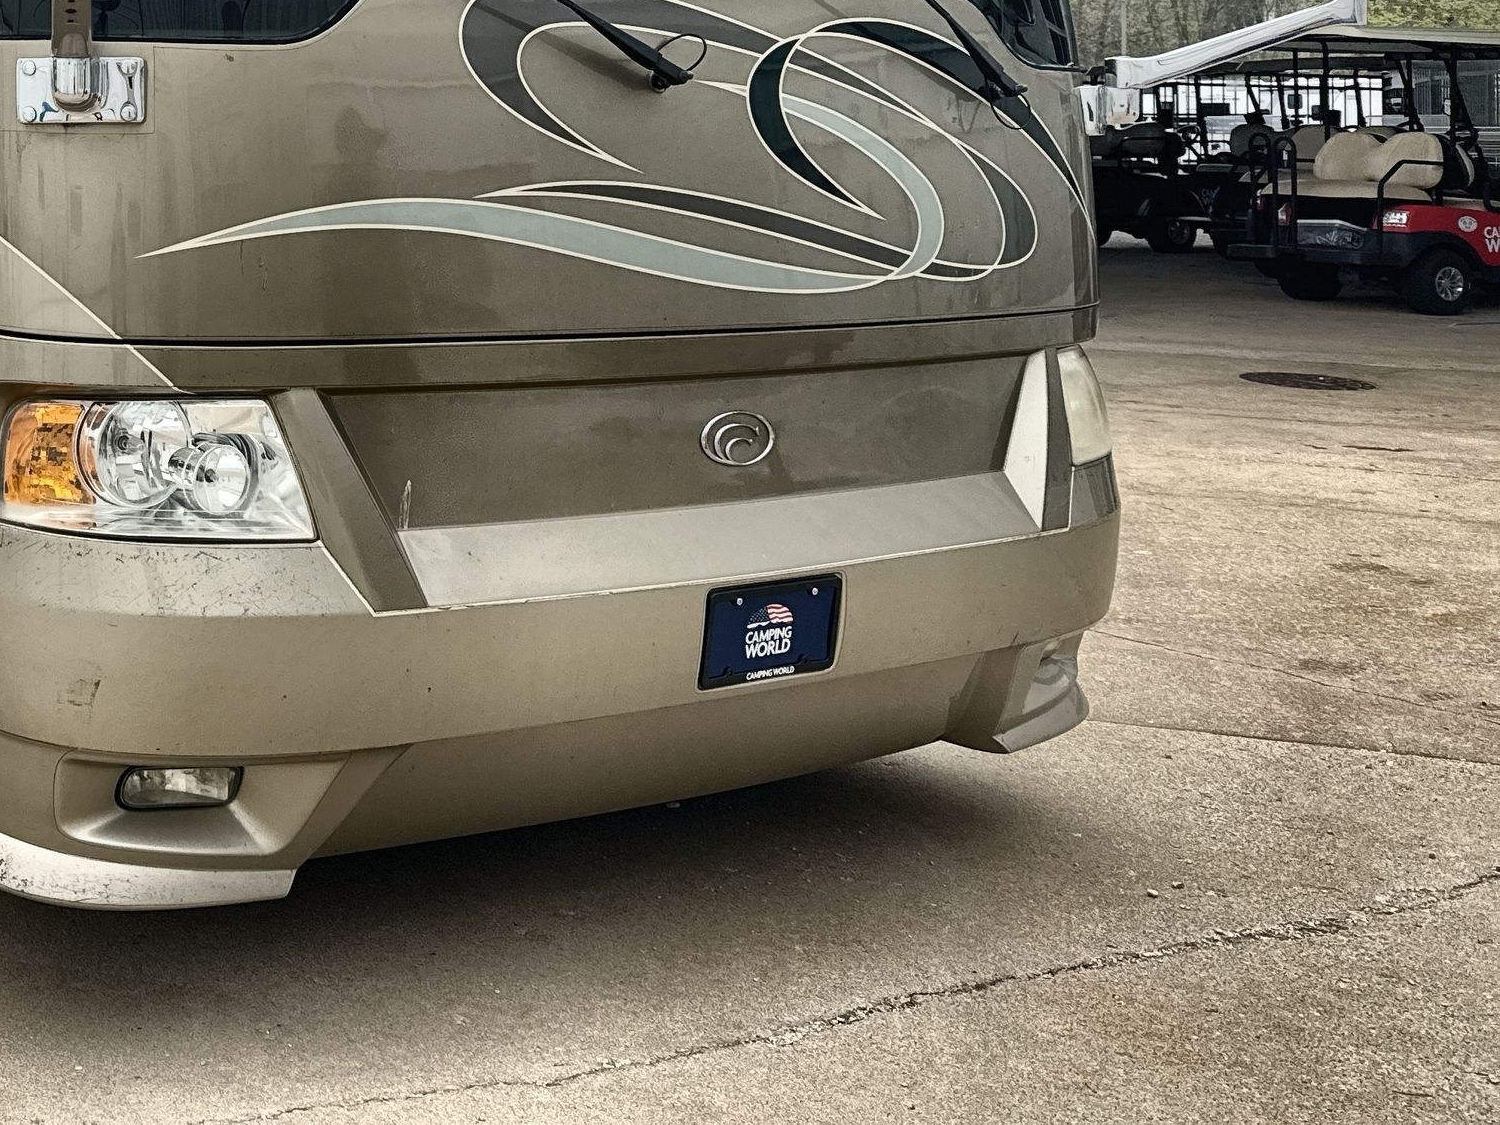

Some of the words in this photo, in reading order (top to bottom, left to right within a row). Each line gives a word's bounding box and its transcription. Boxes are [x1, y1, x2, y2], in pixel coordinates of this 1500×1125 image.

[746, 626, 792, 644] CAMPING
[745, 639, 791, 660] WORLD
[746, 668, 773, 680] CAMPING
[773, 666, 795, 675] WORLD
